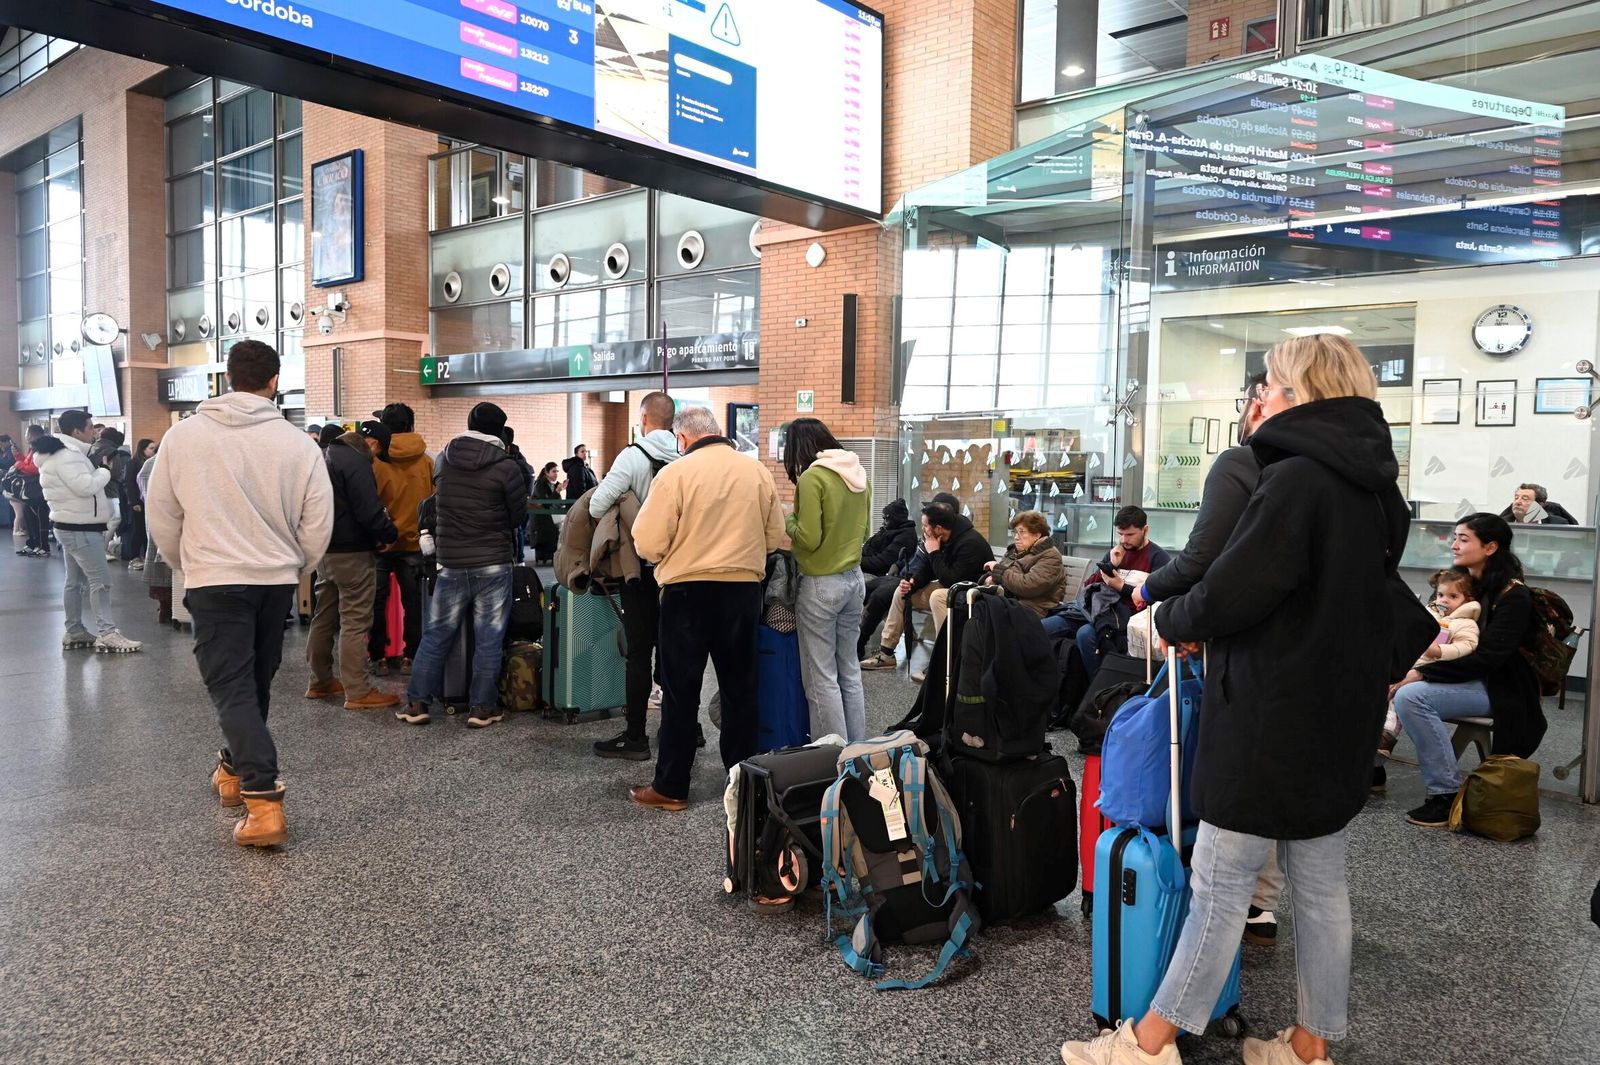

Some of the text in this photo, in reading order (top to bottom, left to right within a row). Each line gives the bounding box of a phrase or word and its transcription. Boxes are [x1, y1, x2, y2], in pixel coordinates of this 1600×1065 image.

[520, 13, 549, 31] 10070
[568, 29, 579, 45] 3
[1189, 244, 1266, 263] Información
[1188, 259, 1260, 276] INFORMATION
[593, 351, 616, 362] Salida
[678, 341, 738, 357] aparcamiento
[437, 362, 450, 379] P2
